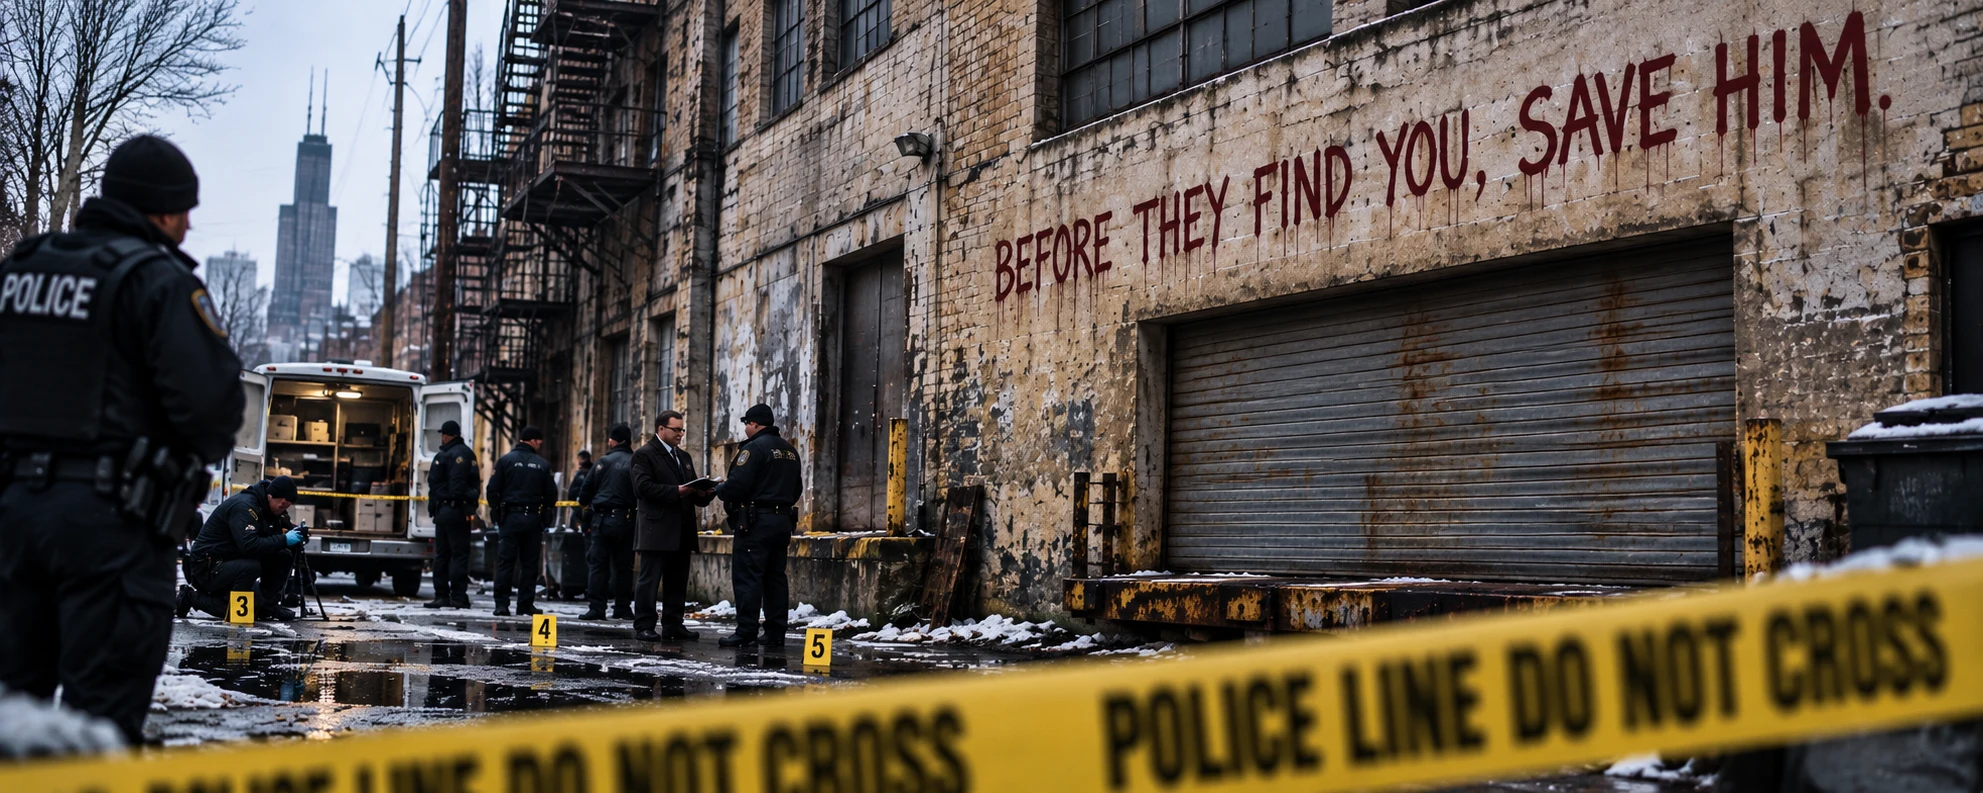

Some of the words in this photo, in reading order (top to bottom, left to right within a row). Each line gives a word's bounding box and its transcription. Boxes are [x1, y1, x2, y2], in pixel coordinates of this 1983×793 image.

[995, 211, 1112, 301] BEFORE
[1133, 175, 1229, 265] THEY
[1253, 145, 1352, 237] FIND
[1376, 108, 1486, 207] YOU,
[1518, 53, 1678, 176] SAVE
[1713, 11, 1892, 136] HIM.
[0, 272, 97, 320] POLICE
[236, 596, 248, 617] 3
[538, 618, 551, 639] 4
[811, 634, 825, 658] 5
[1103, 667, 1324, 791] POLICE
[1340, 647, 1487, 766] LINE
[1509, 633, 1596, 745] DO
[1616, 612, 1739, 733] NOT
[1766, 588, 1950, 713] CROSS
[763, 705, 969, 793] CROSS
